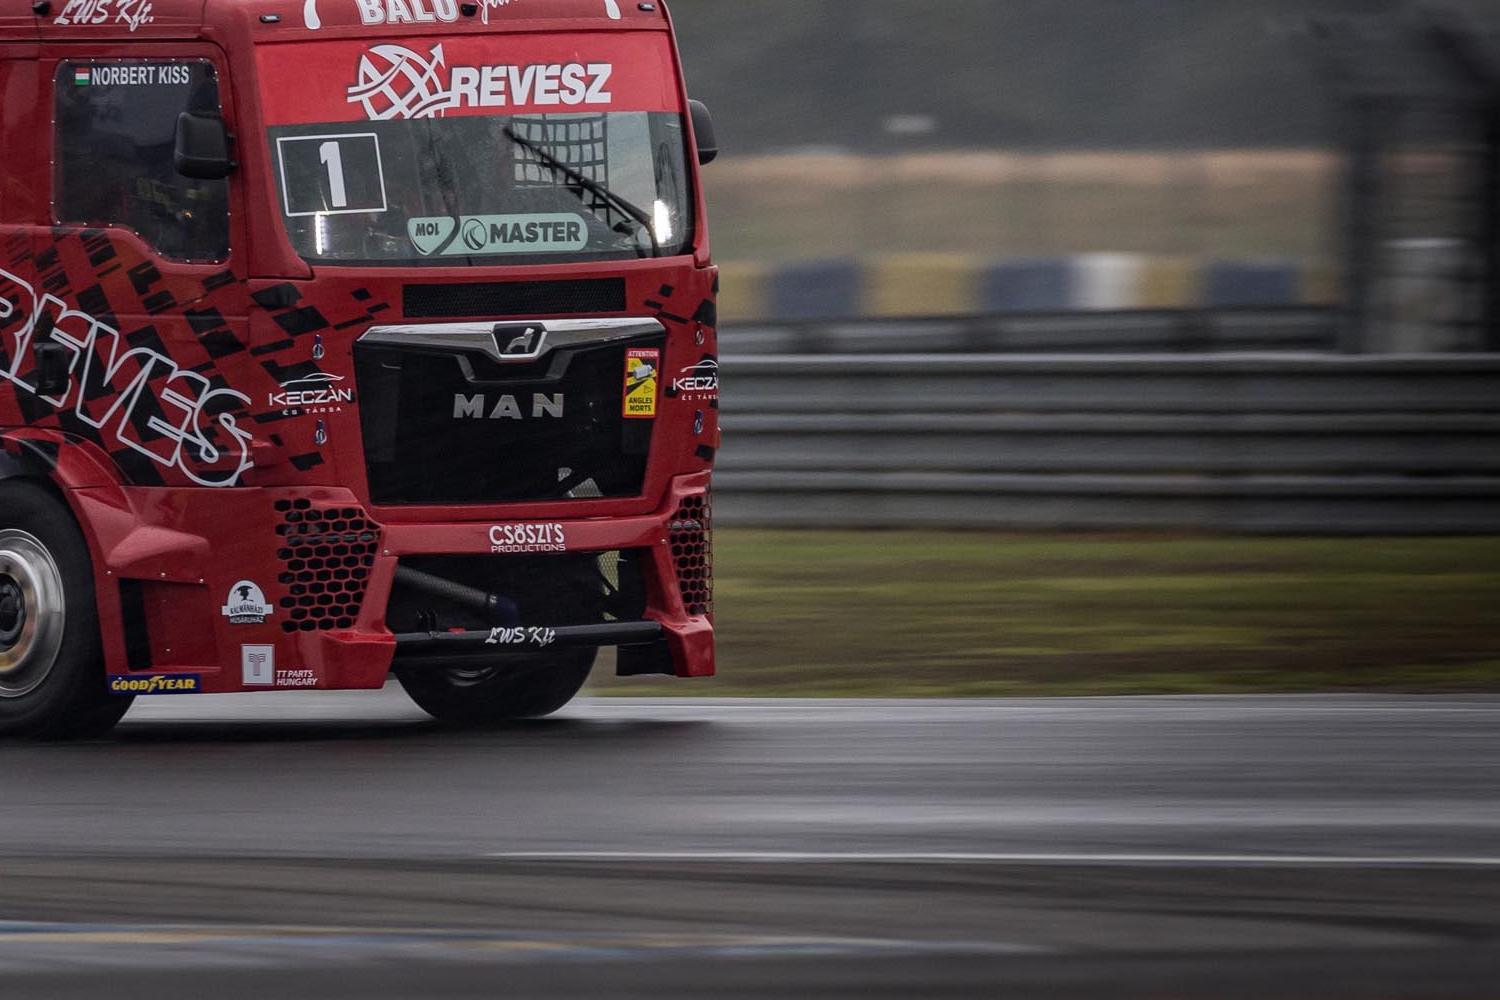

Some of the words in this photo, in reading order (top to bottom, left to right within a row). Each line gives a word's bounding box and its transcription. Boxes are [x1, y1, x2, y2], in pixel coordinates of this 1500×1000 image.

[91, 66, 155, 86] NORBERT
[158, 65, 190, 84] KISS
[320, 141, 347, 207] 1
[490, 222, 581, 244] MASTER
[453, 393, 564, 420] MAN
[629, 404, 651, 412] MORTS
[491, 544, 567, 553] PRODUCTIONS
[485, 626, 525, 643] LWS
[111, 675, 196, 693] GOODYEAR
[276, 678, 318, 686] HUNGARY
